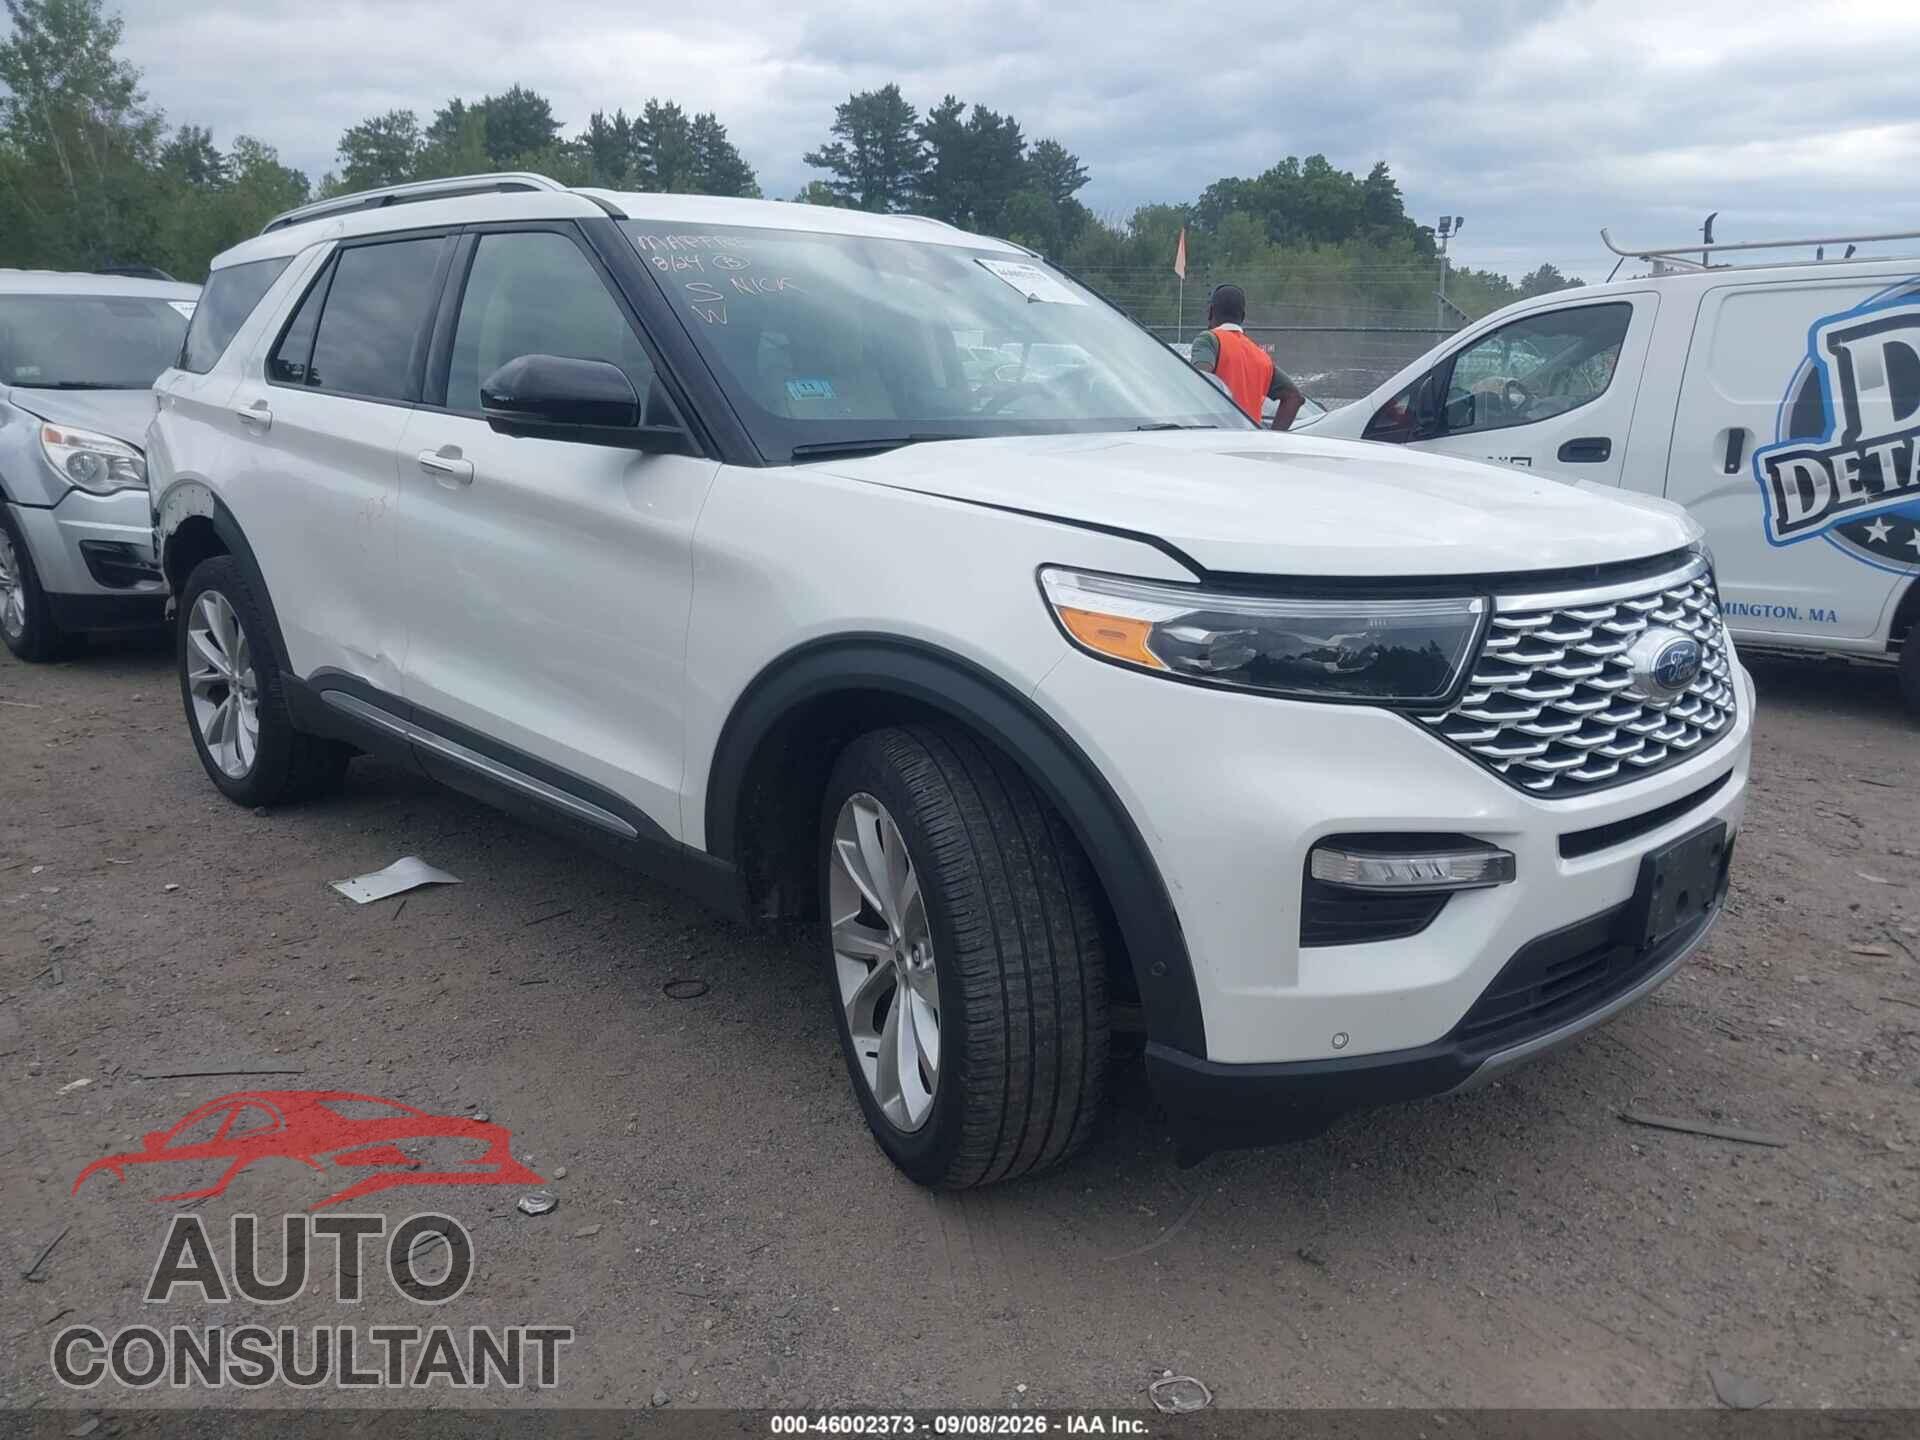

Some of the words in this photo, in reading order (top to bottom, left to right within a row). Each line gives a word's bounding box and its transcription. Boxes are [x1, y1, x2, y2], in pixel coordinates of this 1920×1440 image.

[652, 255, 705, 272] 8/24
[685, 282, 724, 303] S
[1809, 608, 1838, 623] MA
